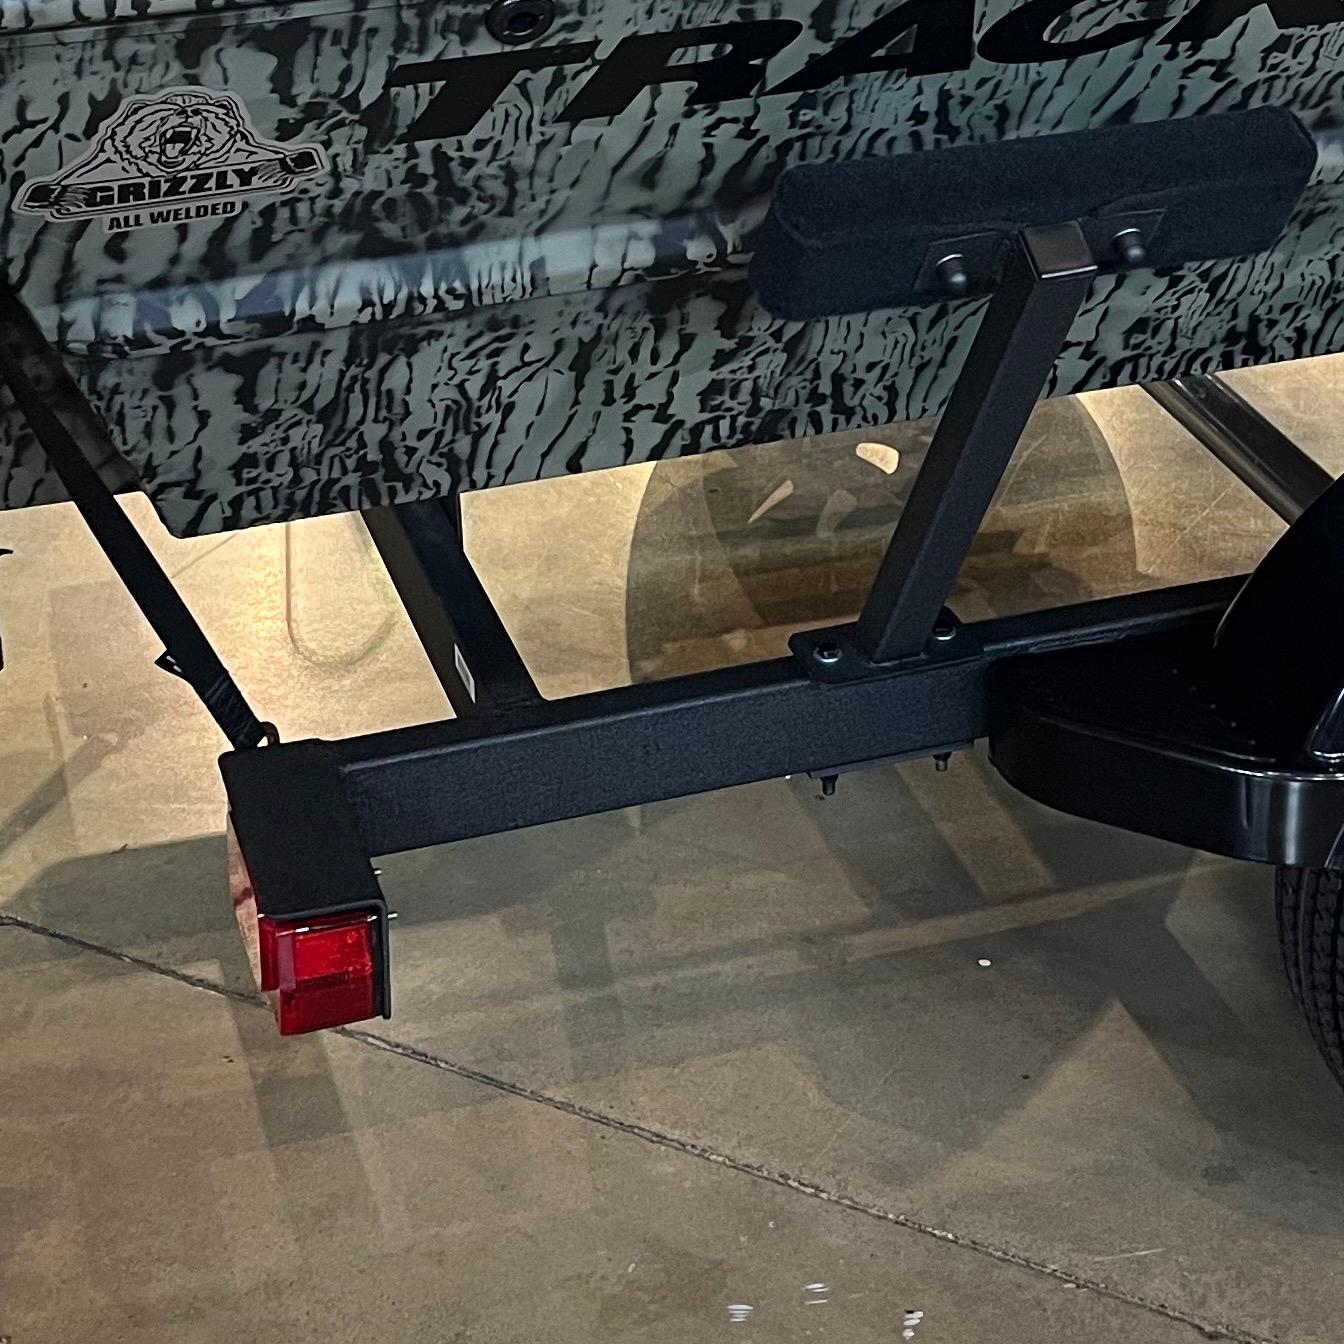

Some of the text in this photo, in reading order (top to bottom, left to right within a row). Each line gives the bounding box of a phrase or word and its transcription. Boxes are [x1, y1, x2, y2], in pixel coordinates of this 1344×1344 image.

[88, 166, 262, 207] GRIZZLY
[108, 201, 236, 231] ALL WELDED
